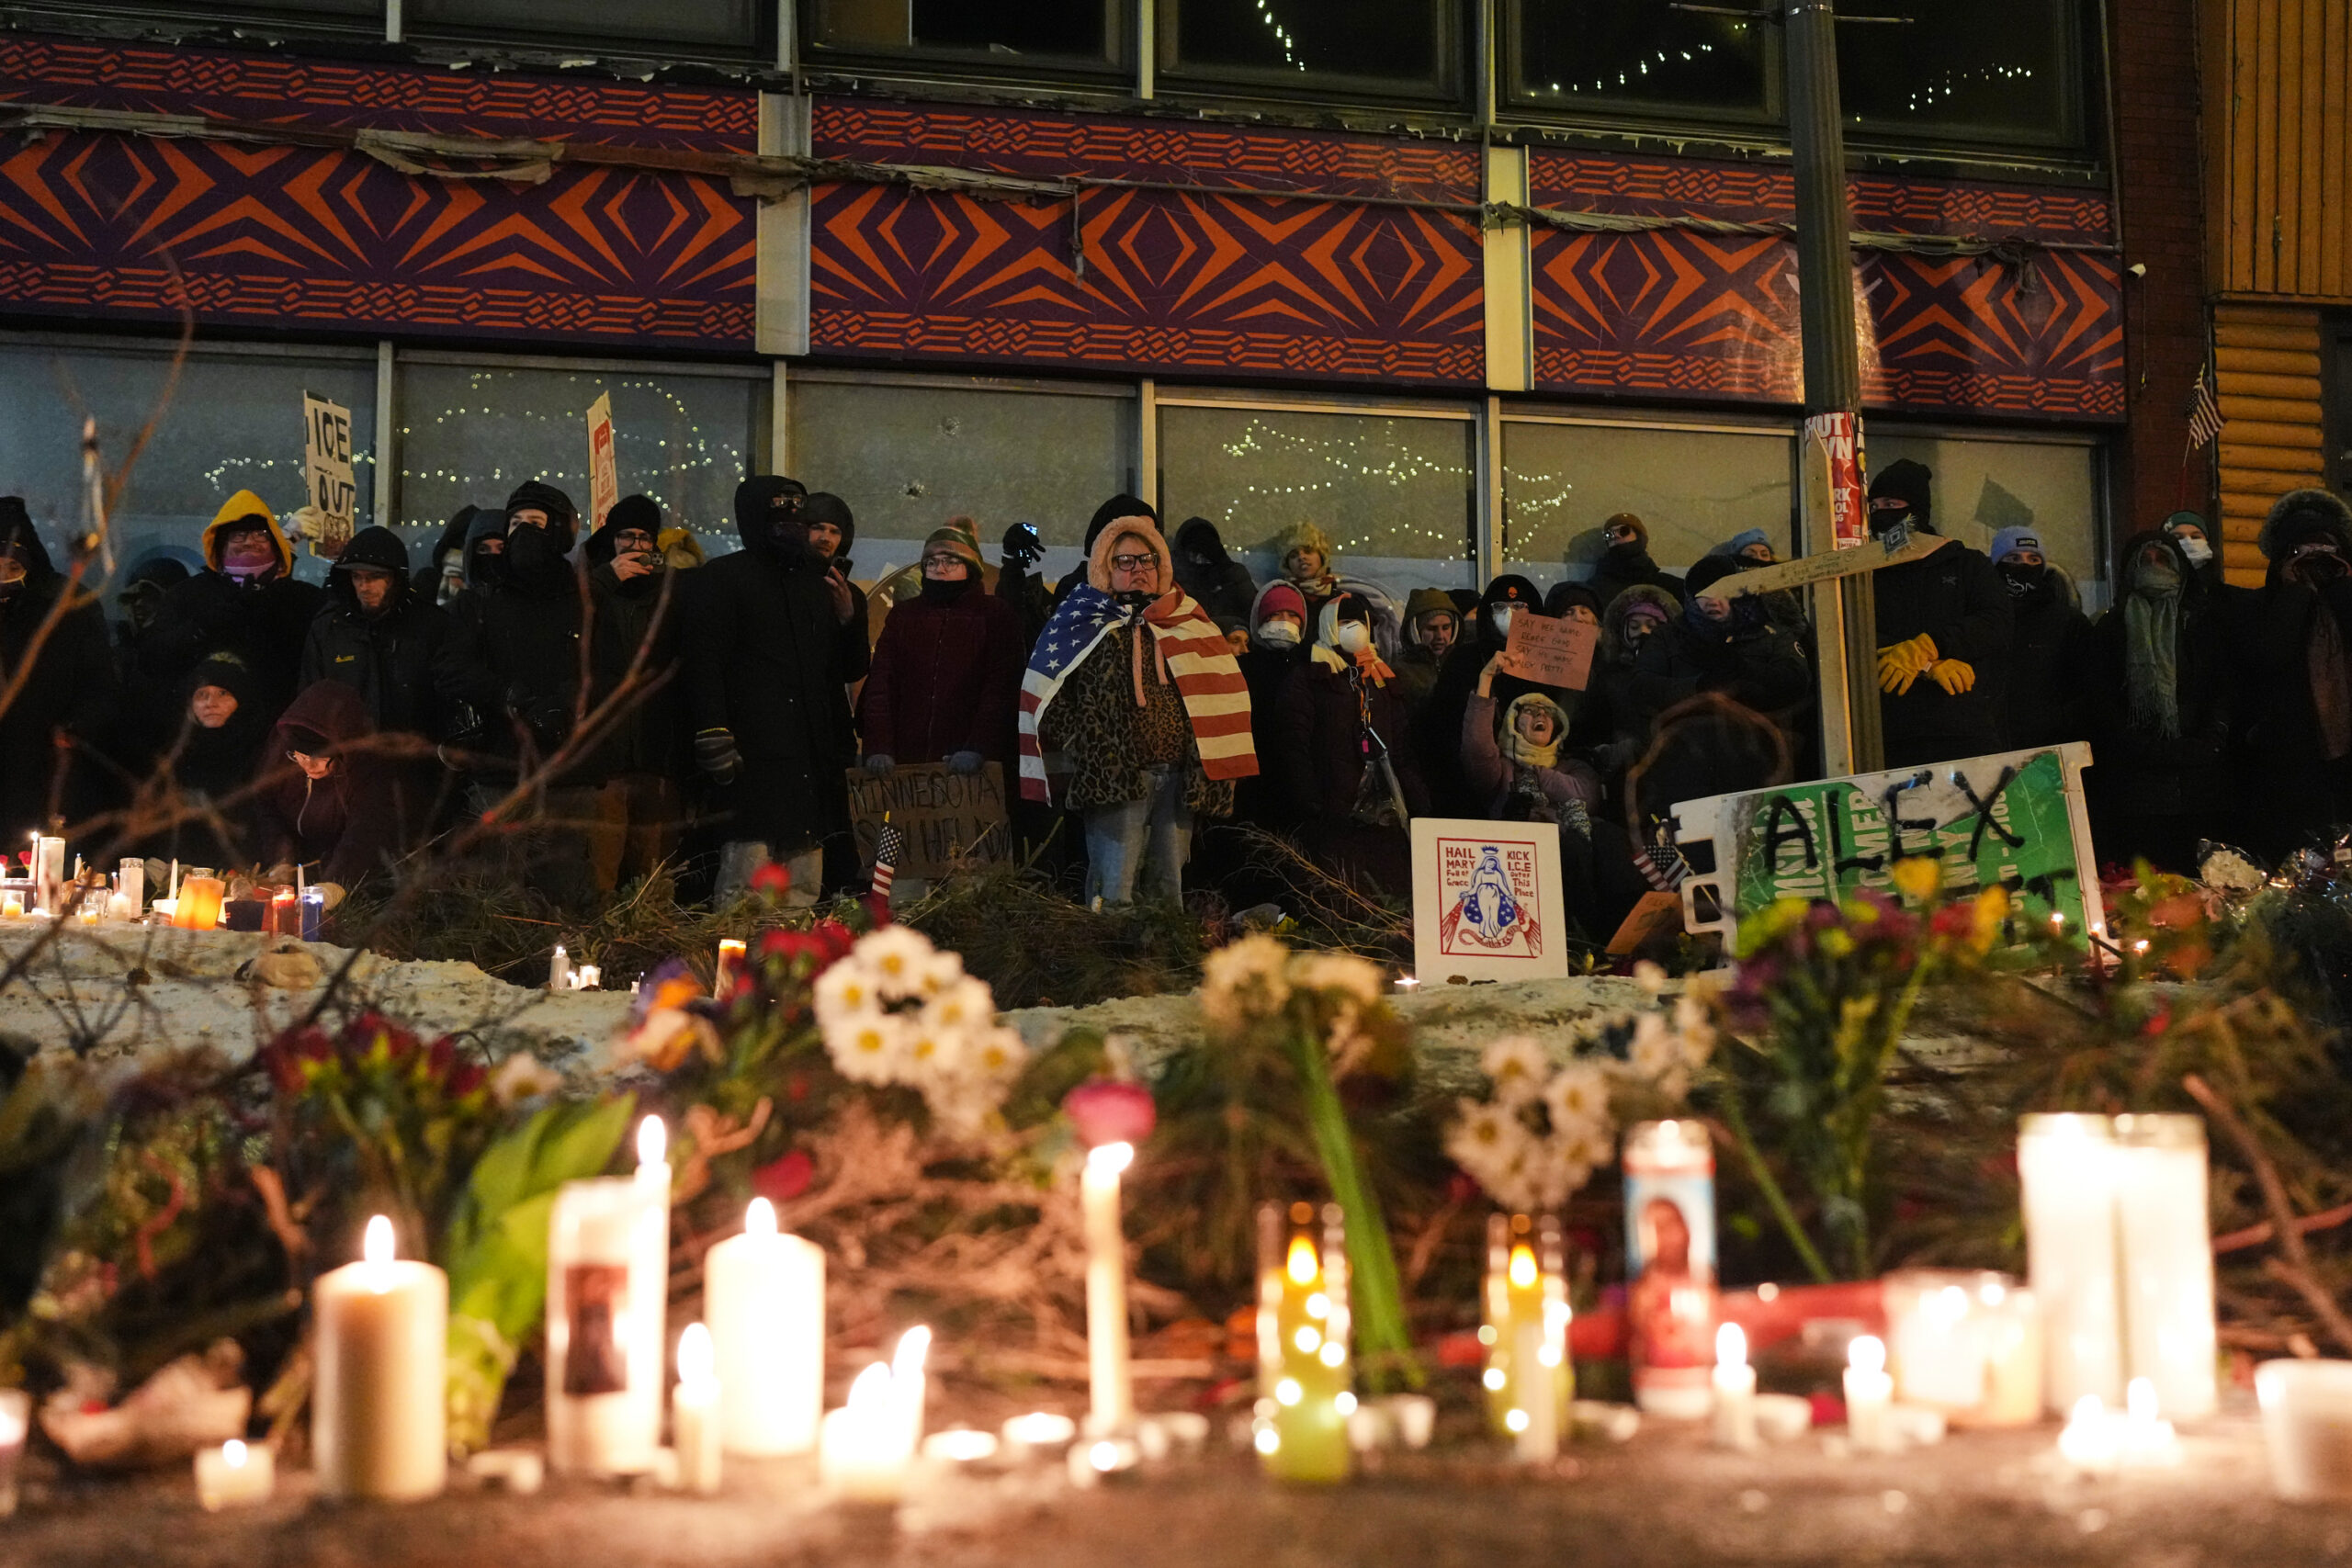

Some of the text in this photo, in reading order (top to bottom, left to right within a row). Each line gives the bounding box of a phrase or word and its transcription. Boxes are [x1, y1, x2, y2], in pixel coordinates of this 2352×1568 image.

[314, 407, 348, 462] ICE
[319, 475, 356, 513] OUT
[1518, 618, 1535, 628] SAY
[1516, 645, 1531, 655] SAY
[849, 770, 1001, 813] MINNESOTA
[1764, 766, 2025, 883] ALEX
[856, 818, 912, 868] SN
[1445, 847, 1476, 859] HAIL
[1446, 860, 1476, 869] MARY
[1507, 851, 1529, 861] KICK
[1937, 829, 1978, 889] NLY
[1512, 878, 1530, 886] This
